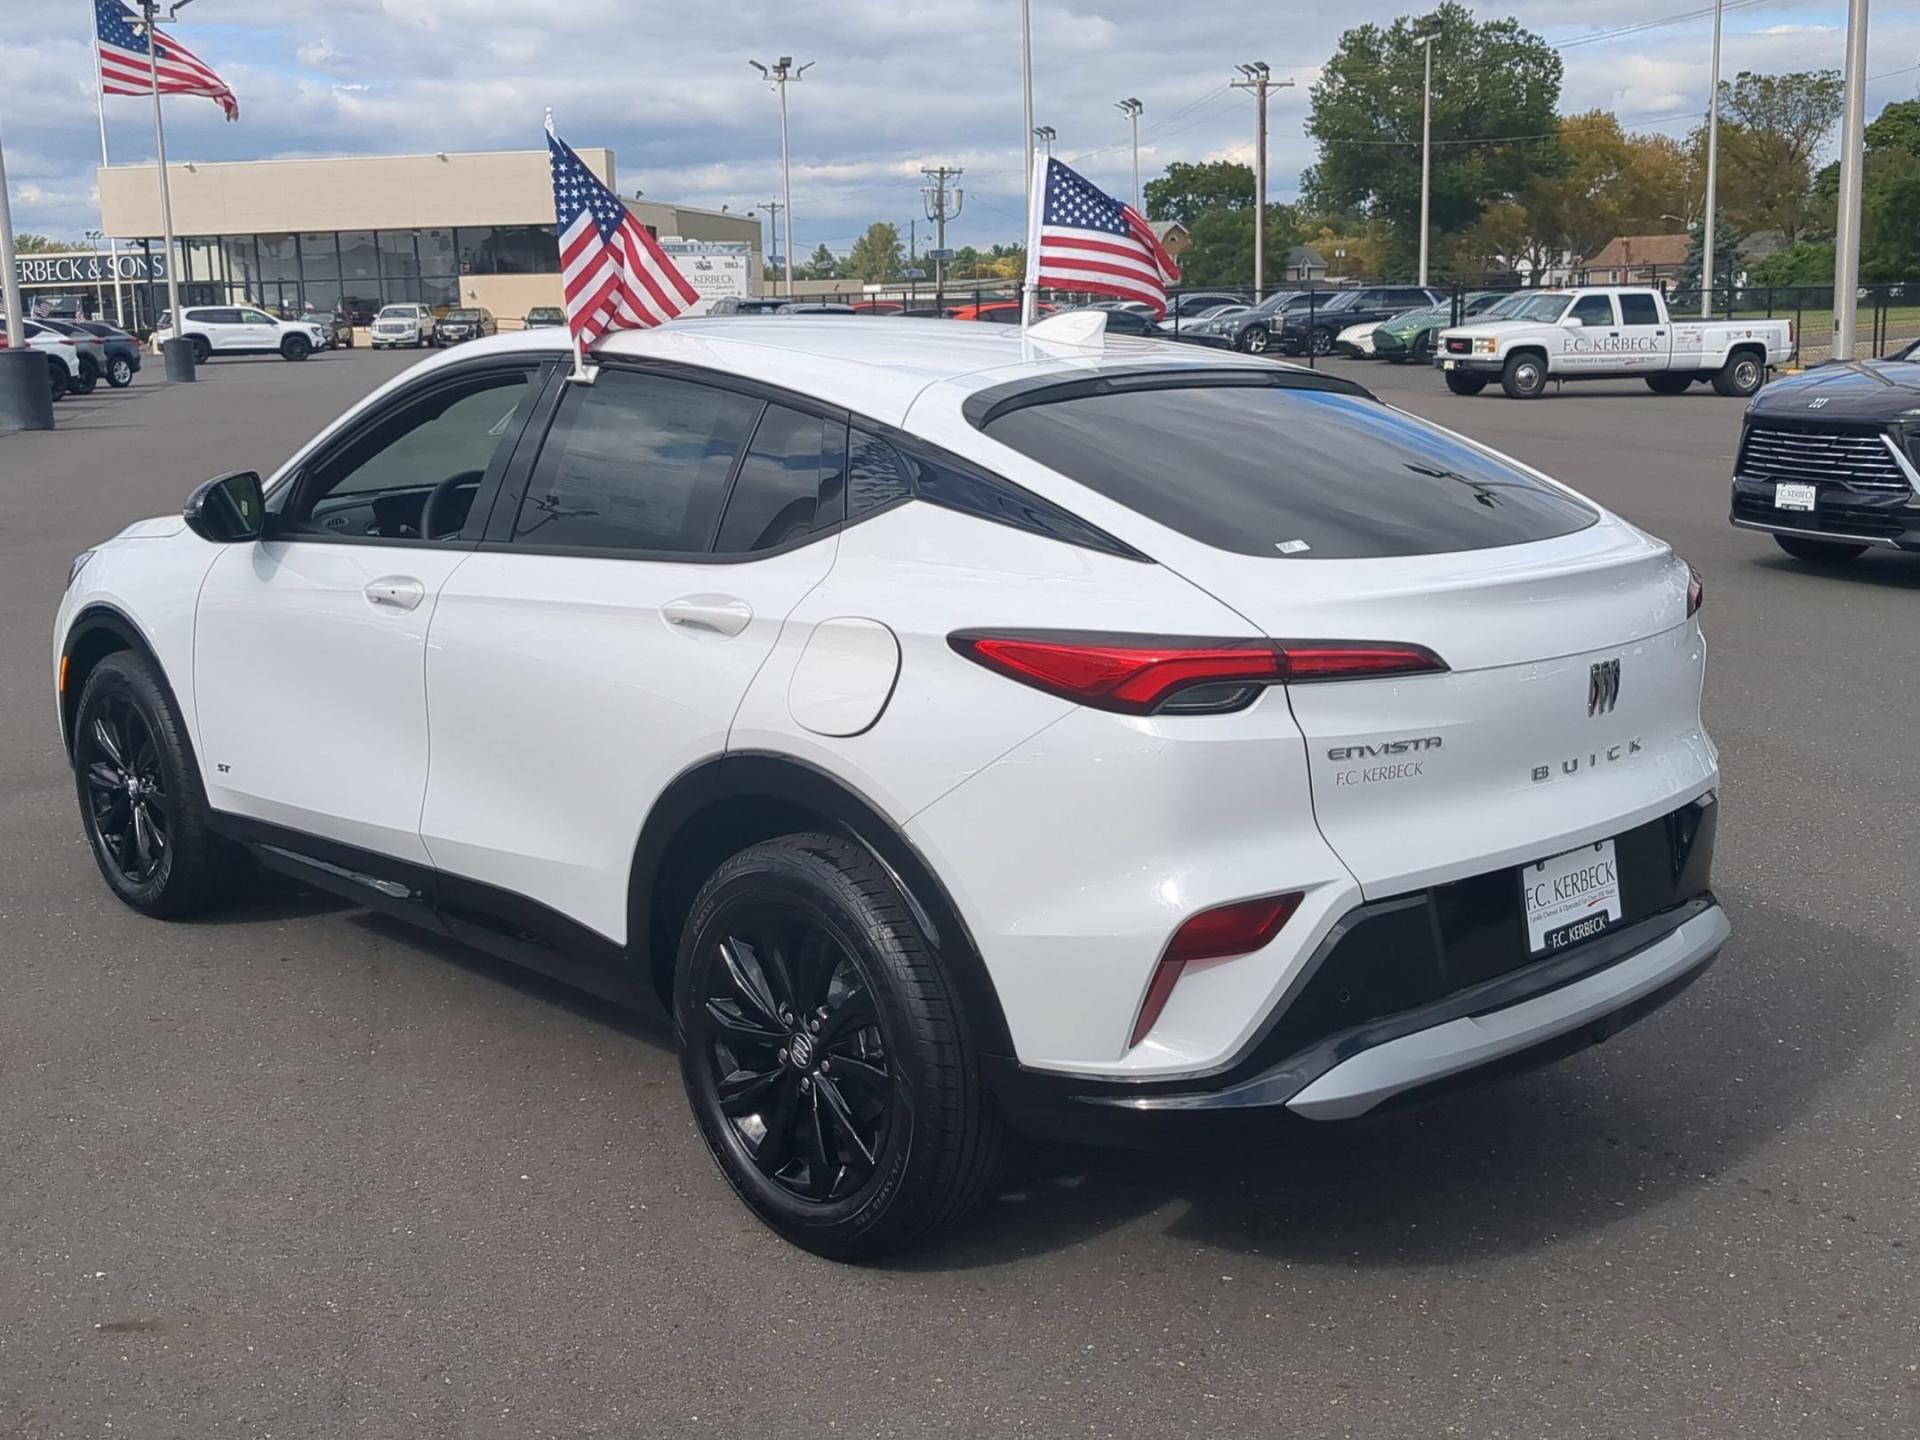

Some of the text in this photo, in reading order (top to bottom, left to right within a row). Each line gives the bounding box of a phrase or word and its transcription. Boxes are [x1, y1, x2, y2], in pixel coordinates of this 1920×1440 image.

[15, 255, 164, 282] ERBECK & SONS
[1563, 337, 1658, 352] F.C. KERBECK
[1327, 736, 1442, 761] ENVISTA
[1531, 737, 1642, 781] BUICK
[217, 763, 231, 773] ST
[1363, 761, 1424, 783] KERBECK
[1525, 859, 1615, 911] F.C. KERBECK
[1552, 915, 1606, 948] F.C. KERBECK
